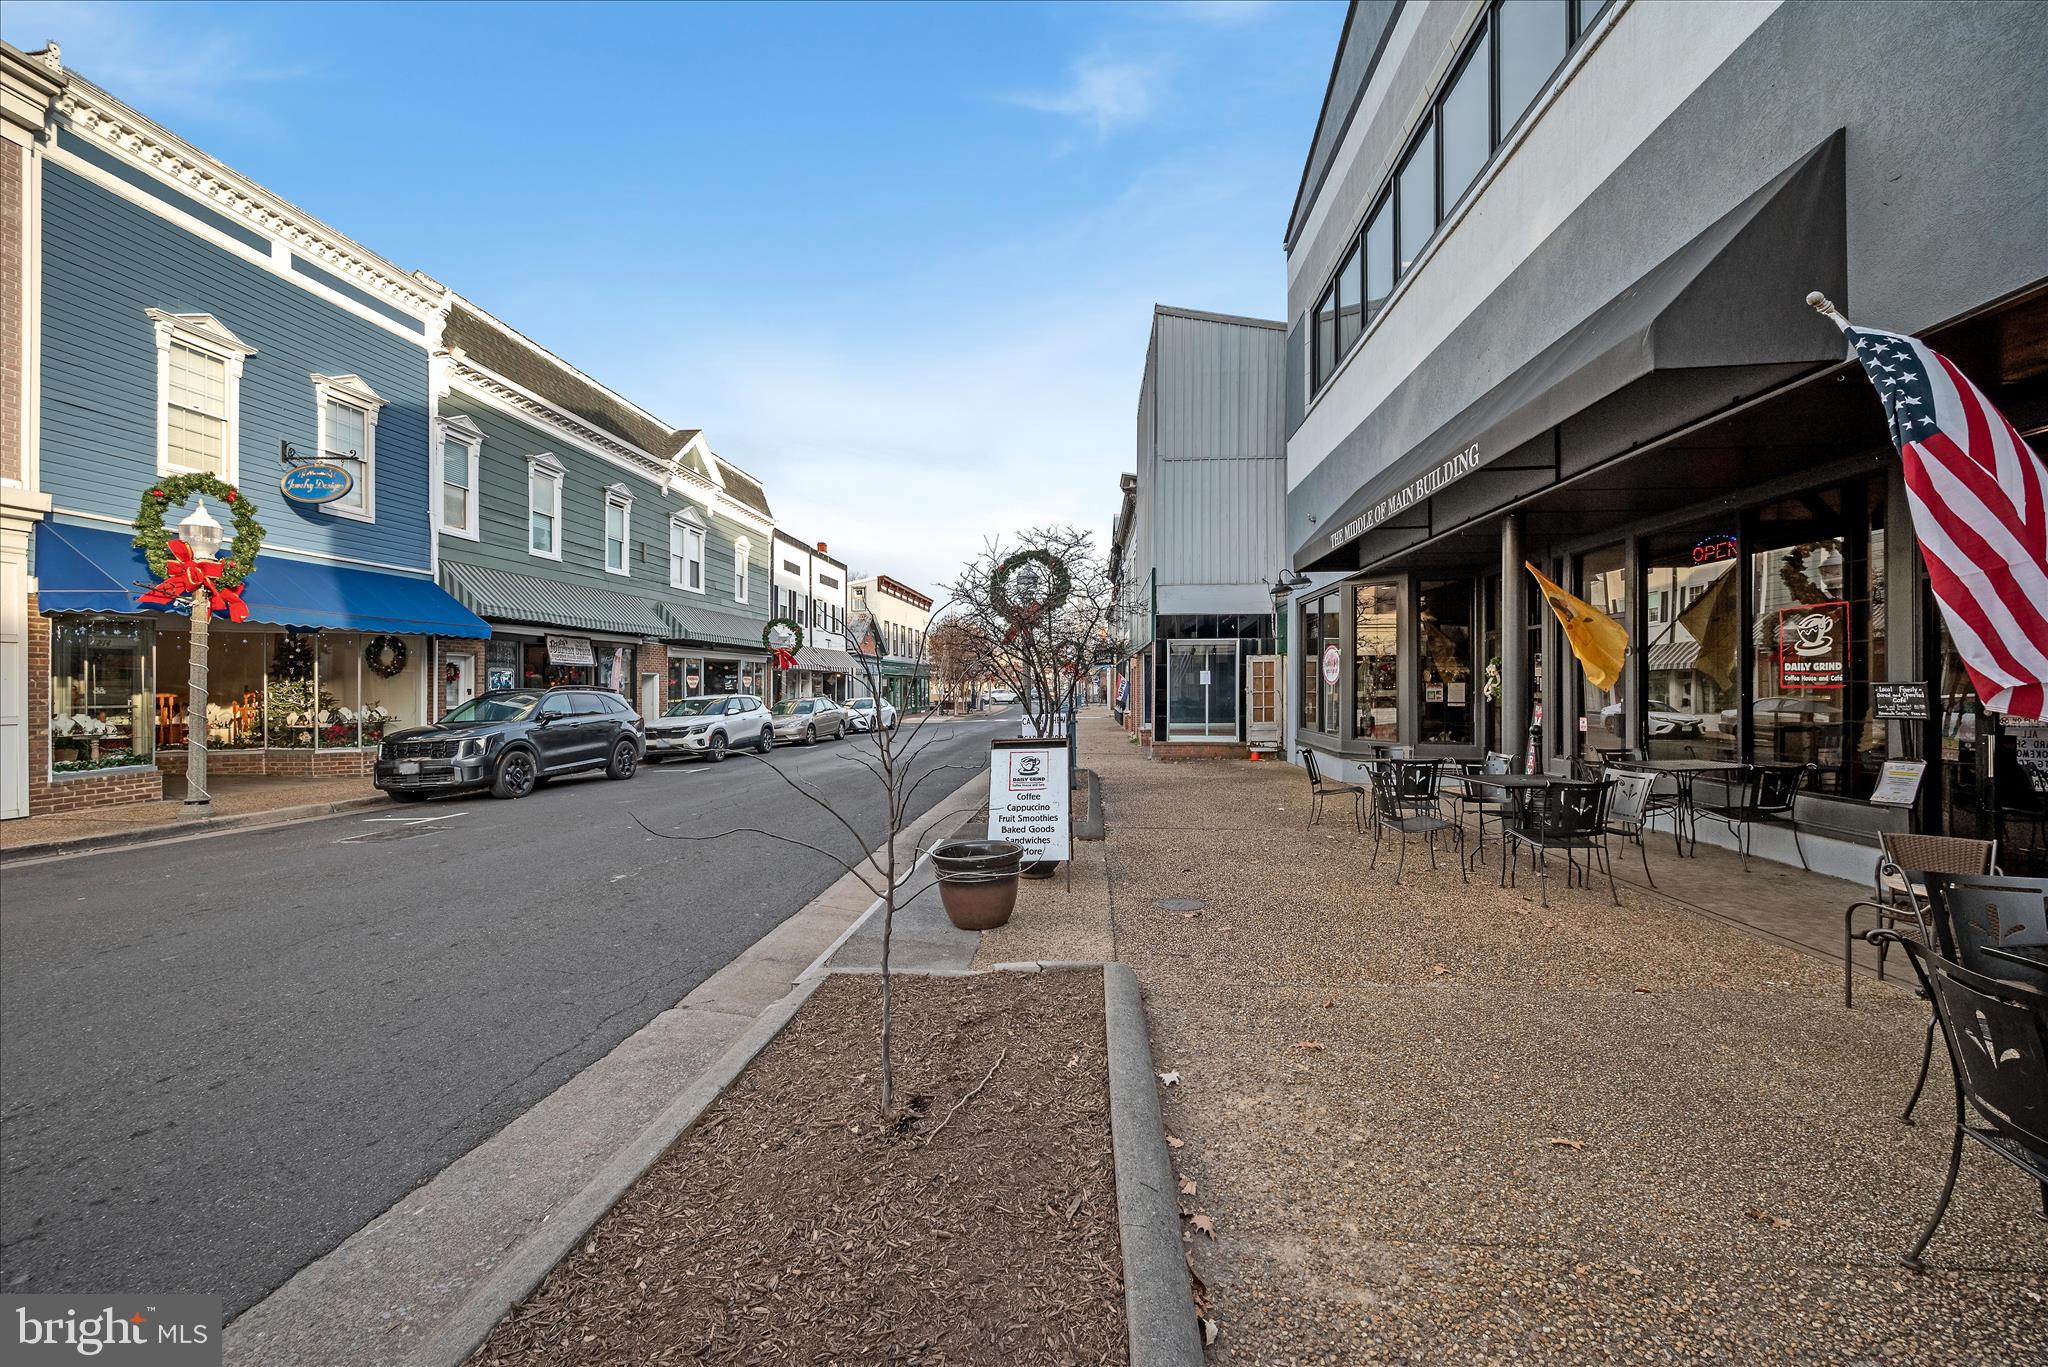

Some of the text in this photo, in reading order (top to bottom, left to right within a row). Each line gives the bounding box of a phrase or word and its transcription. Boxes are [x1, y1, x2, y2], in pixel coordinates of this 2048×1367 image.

[1330, 442, 1480, 549] THE MIDDLE OF MAIN BUILDING
[1692, 541, 1738, 562] OPEN
[1784, 662, 1843, 671] DAILY GRIND
[1898, 685, 1918, 694] Family
[1016, 792, 1041, 801] Coffee
[1006, 803, 1051, 814] Cappuccino
[998, 813, 1058, 823] Fruit Smoothies
[1001, 825, 1055, 834] Baked Goods
[1005, 836, 1051, 844] Sandwiches
[1022, 847, 1042, 855] More
